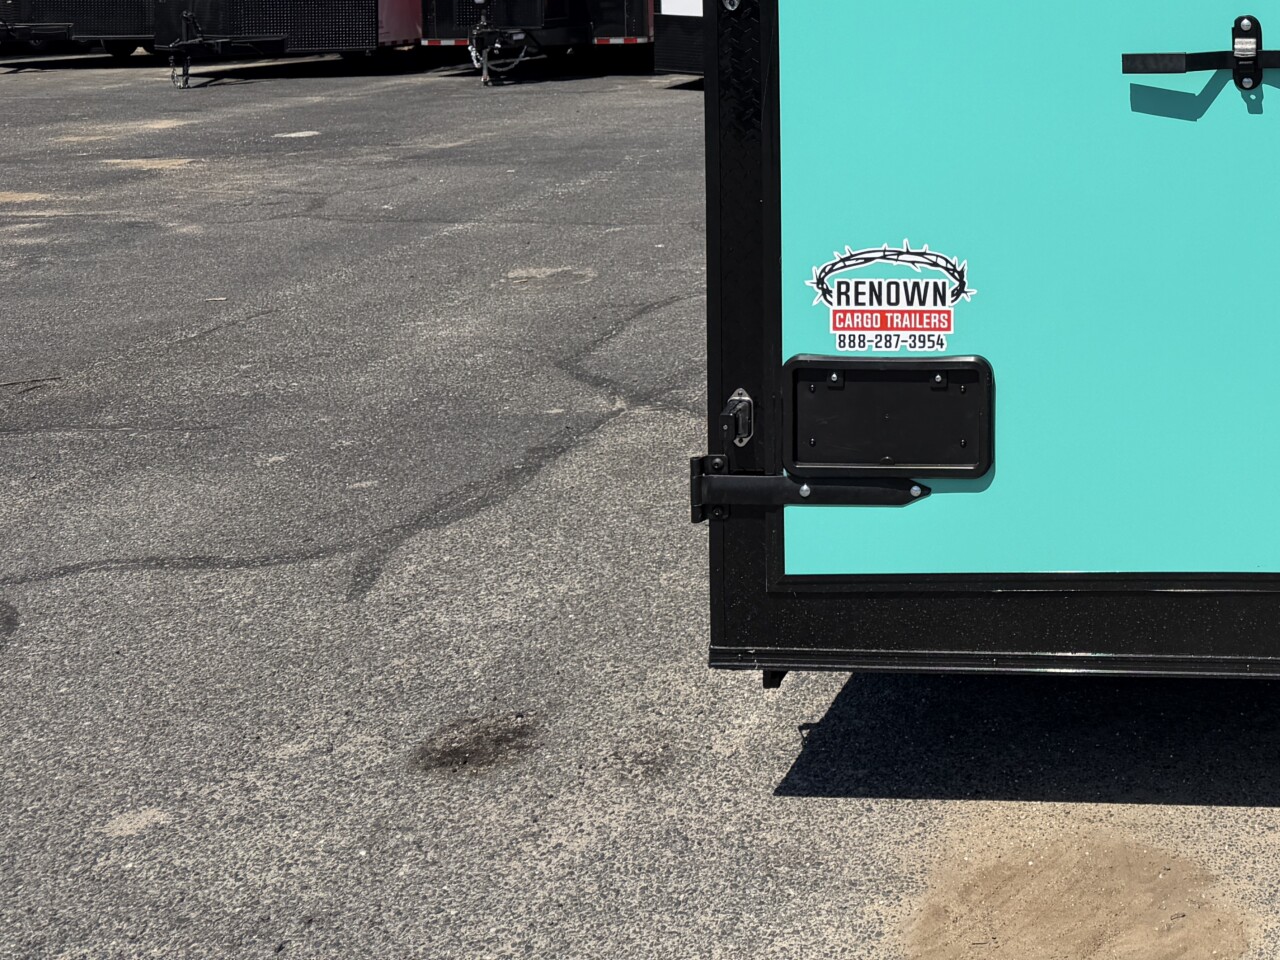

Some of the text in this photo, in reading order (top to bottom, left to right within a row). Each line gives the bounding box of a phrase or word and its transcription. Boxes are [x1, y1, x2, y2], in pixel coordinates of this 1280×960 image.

[836, 280, 947, 307] RENOWN
[835, 312, 949, 329] CARGO TRAILERS
[838, 334, 945, 350] 888-287-3954
